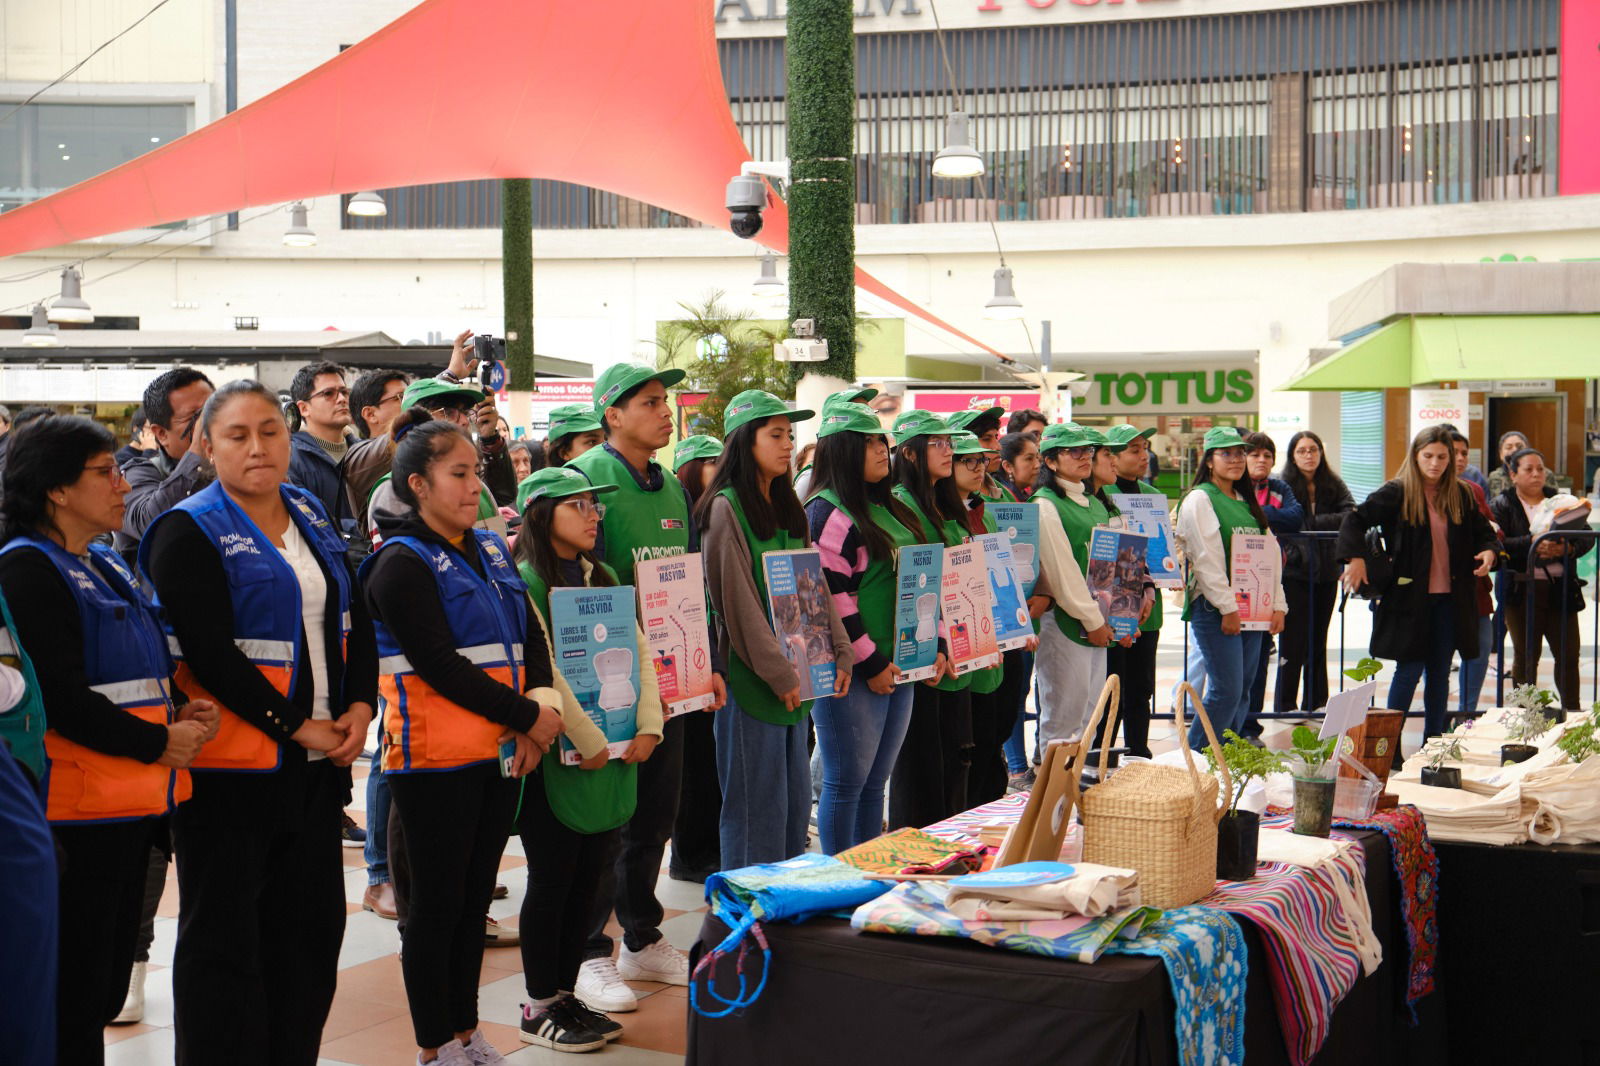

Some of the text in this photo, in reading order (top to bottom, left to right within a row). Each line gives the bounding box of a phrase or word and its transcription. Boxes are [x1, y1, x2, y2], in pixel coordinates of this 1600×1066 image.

[533, 384, 593, 393] emos todo
[1094, 369, 1255, 406] TOTTUS
[1418, 409, 1462, 420] CONOS
[673, 569, 686, 580] VIDA
[578, 602, 613, 616] MÁS VIDA
[560, 625, 588, 636] LIBRES DE
[561, 634, 588, 645] TECNOPOR
